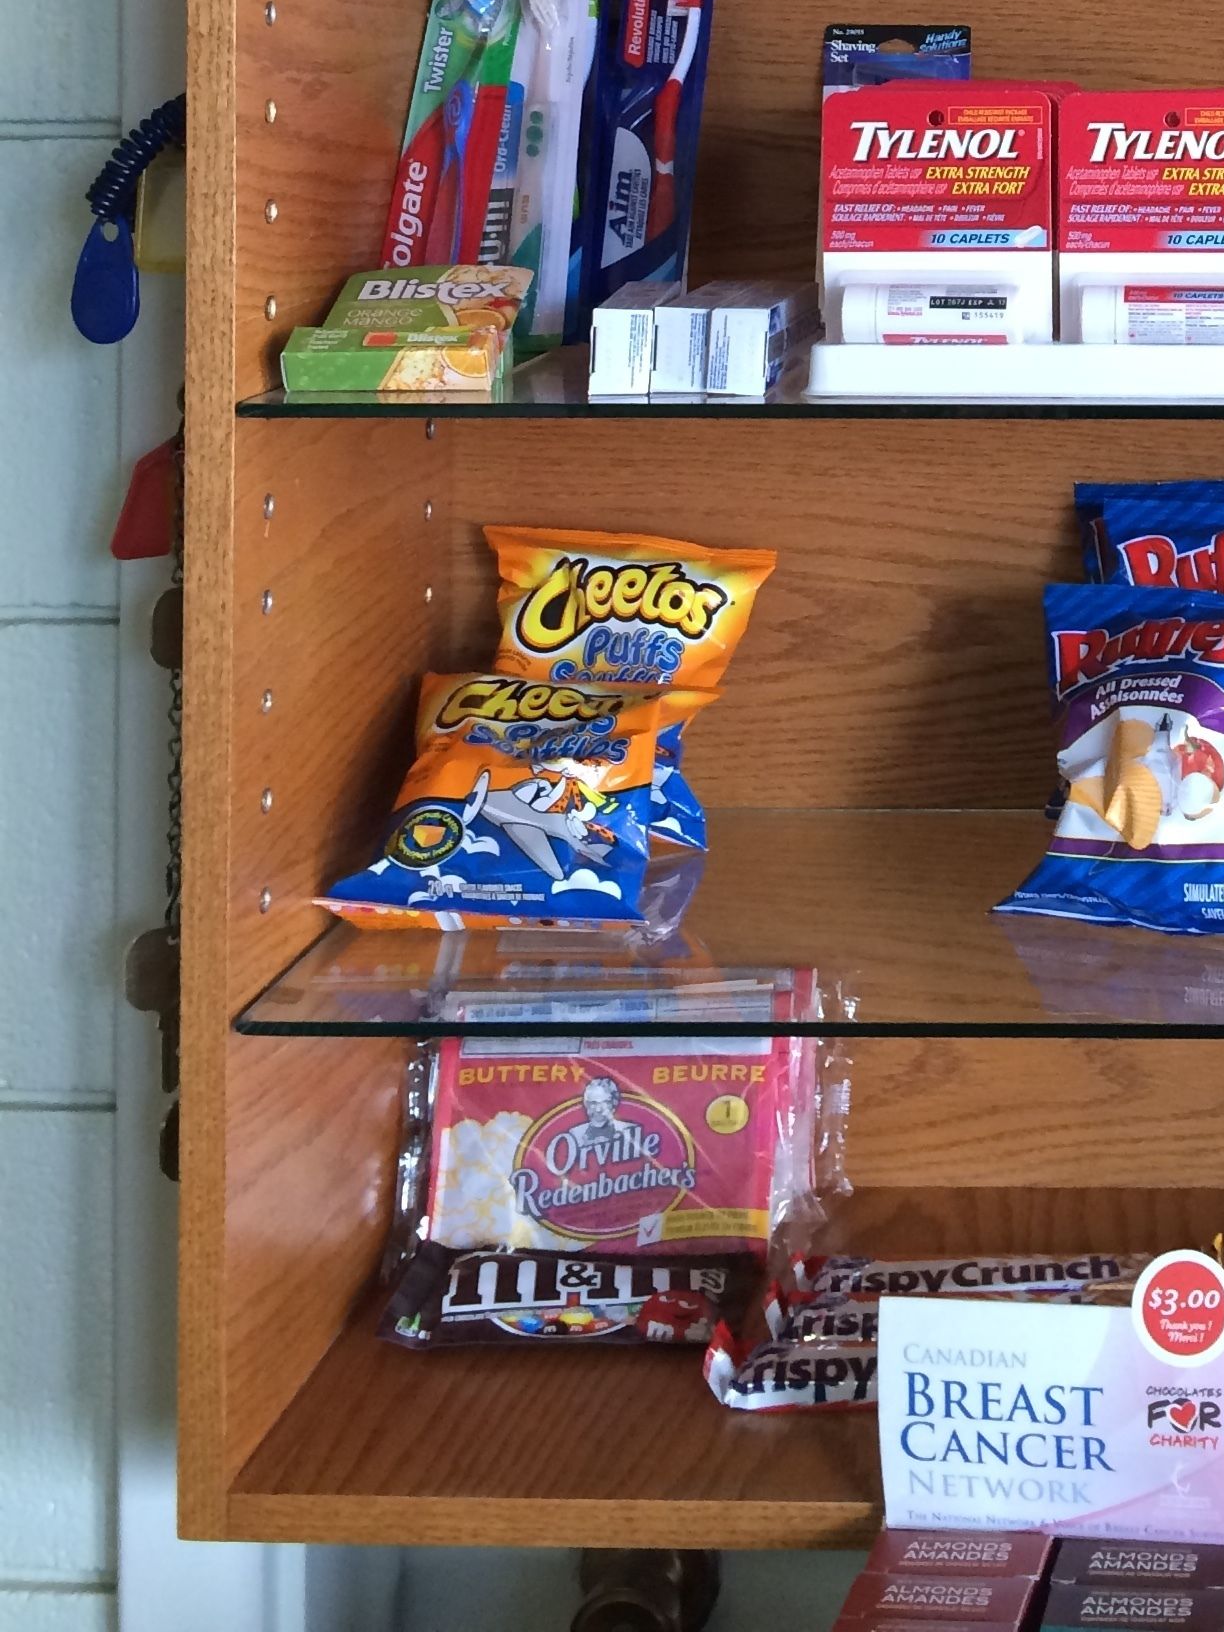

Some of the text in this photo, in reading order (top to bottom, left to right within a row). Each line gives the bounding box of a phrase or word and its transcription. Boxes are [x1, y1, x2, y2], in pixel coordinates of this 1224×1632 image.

[926, 29, 961, 44] Handy
[831, 40, 876, 54] Shaving
[919, 39, 968, 53] Solutions
[425, 26, 453, 94] Twister
[831, 52, 848, 63] Set
[850, 122, 1019, 161] TYLENOL
[926, 166, 1030, 179] EXTRA STRENGTH
[1163, 168, 1200, 180] EXTRA
[952, 182, 1025, 194] EXTRA FORT
[384, 160, 428, 268] olgate
[608, 170, 633, 246] Aim
[931, 233, 1009, 244] 10 CAPLETS
[1167, 234, 1181, 245] 10
[358, 279, 507, 304] Blistex
[517, 557, 727, 652] Cheetos
[583, 626, 685, 672] Puffs
[1096, 675, 1183, 700] All Dressed
[459, 1062, 584, 1086] BUTTERY
[652, 1064, 766, 1084] BEURRE
[545, 1124, 661, 1176] Orville
[511, 1161, 697, 1217] Redenbacher's
[951, 1255, 1120, 1288] Crunch
[1148, 1288, 1221, 1316] $3.00
[1159, 1318, 1187, 1331] Thank
[903, 1343, 1028, 1369] CANADIAN
[904, 1371, 1105, 1427] BREAST
[1146, 1384, 1223, 1398] CHOCOLATES
[900, 1420, 1117, 1473] CANCER
[1149, 1433, 1219, 1450] CHARITY
[907, 1470, 1093, 1505] NETWORK
[906, 1541, 1012, 1552] ALMONDS
[904, 1551, 1009, 1561] AMANDES
[1090, 1551, 1198, 1562] ALMONDS
[1088, 1561, 1196, 1572] AMANDES
[884, 1585, 992, 1596] ALMONDS
[881, 1595, 989, 1606] AMANDES
[1082, 1596, 1193, 1607] ALMONDS
[1080, 1606, 1192, 1616] AMANDES
